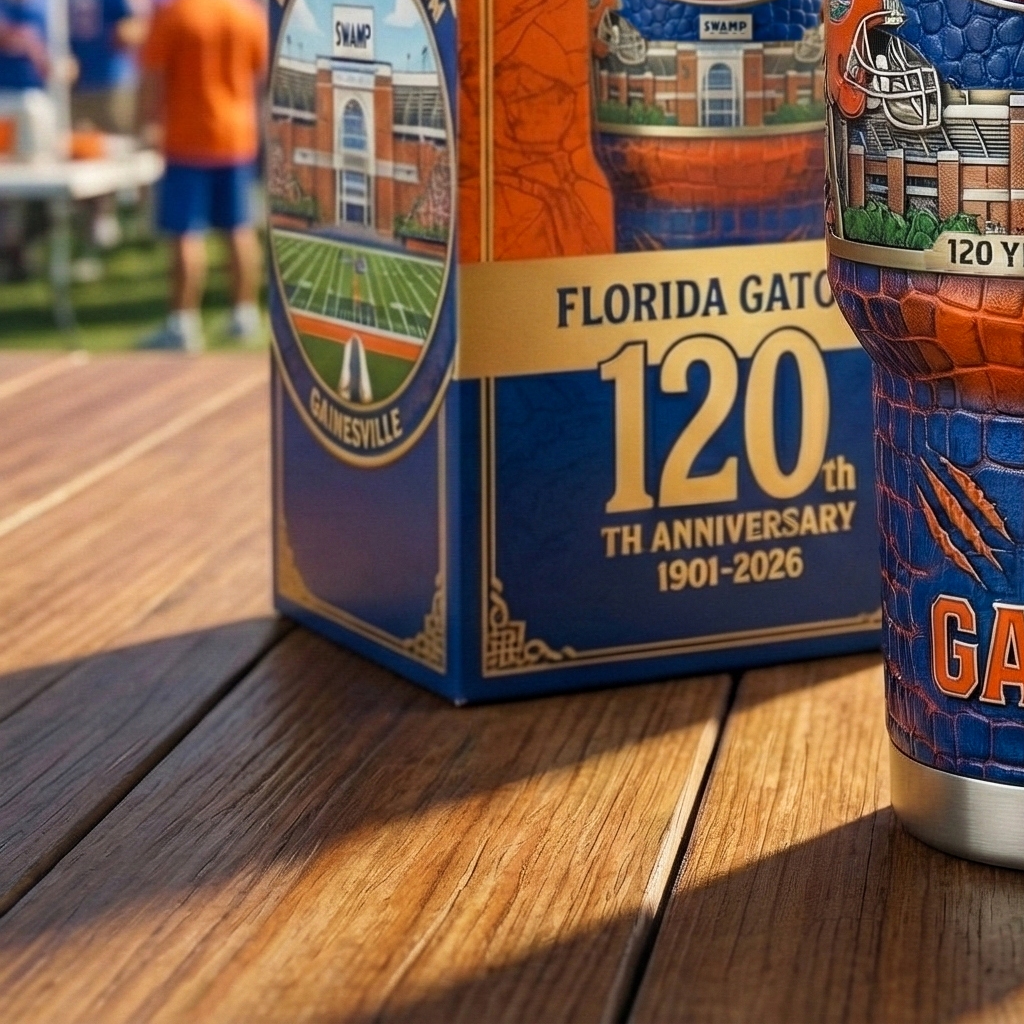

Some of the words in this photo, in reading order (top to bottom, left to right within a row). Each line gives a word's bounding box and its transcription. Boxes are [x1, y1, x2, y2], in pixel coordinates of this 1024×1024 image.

[335, 20, 371, 49] SWAMP
[704, 21, 747, 32] SWAMP
[947, 238, 993, 267] 120
[556, 276, 728, 329] FLORIDA
[309, 386, 404, 450] GAINESVILLE
[600, 523, 642, 558] TH
[650, 500, 857, 554] ANNIVERSARY
[657, 546, 804, 592] 1901-2026
